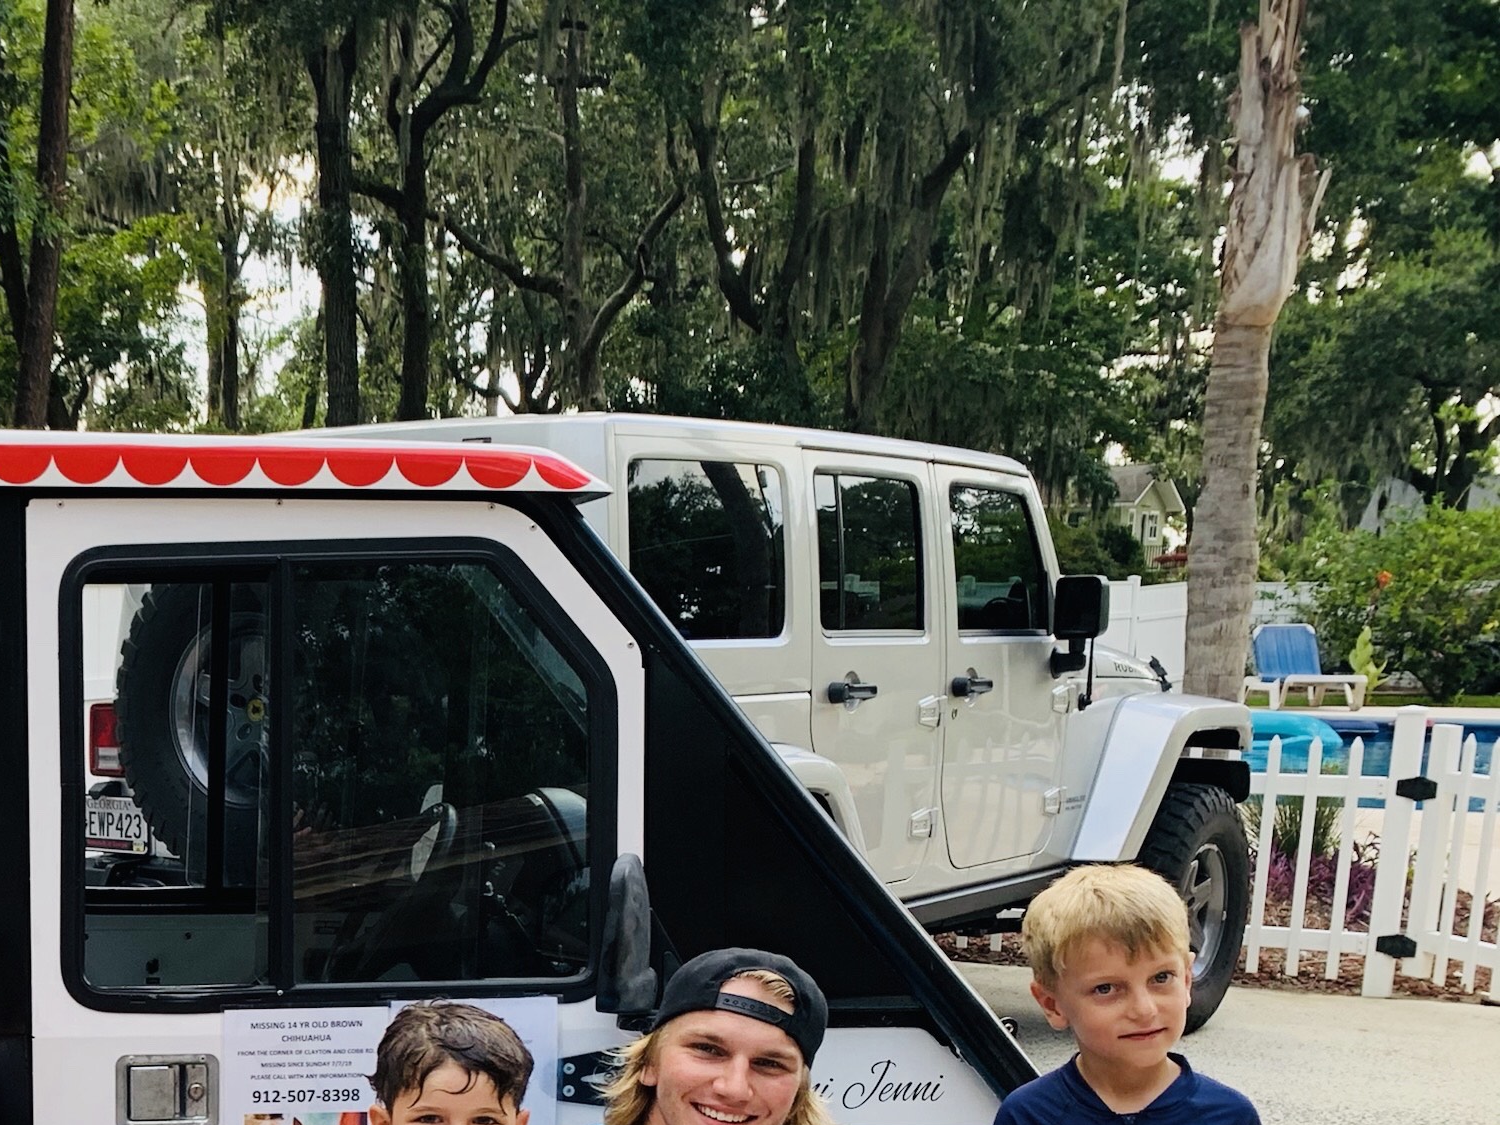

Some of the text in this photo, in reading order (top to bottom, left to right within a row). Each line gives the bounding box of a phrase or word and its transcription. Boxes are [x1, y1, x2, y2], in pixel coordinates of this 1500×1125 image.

[87, 799, 129, 811] GEORGIA
[250, 1021, 286, 1030] MISSING
[288, 1021, 298, 1029] 14
[330, 1019, 363, 1028] BROWN
[281, 1034, 332, 1043] CHIHUAHUA
[842, 1059, 946, 1110] Jenni
[252, 1088, 360, 1104] 912-507-8398
